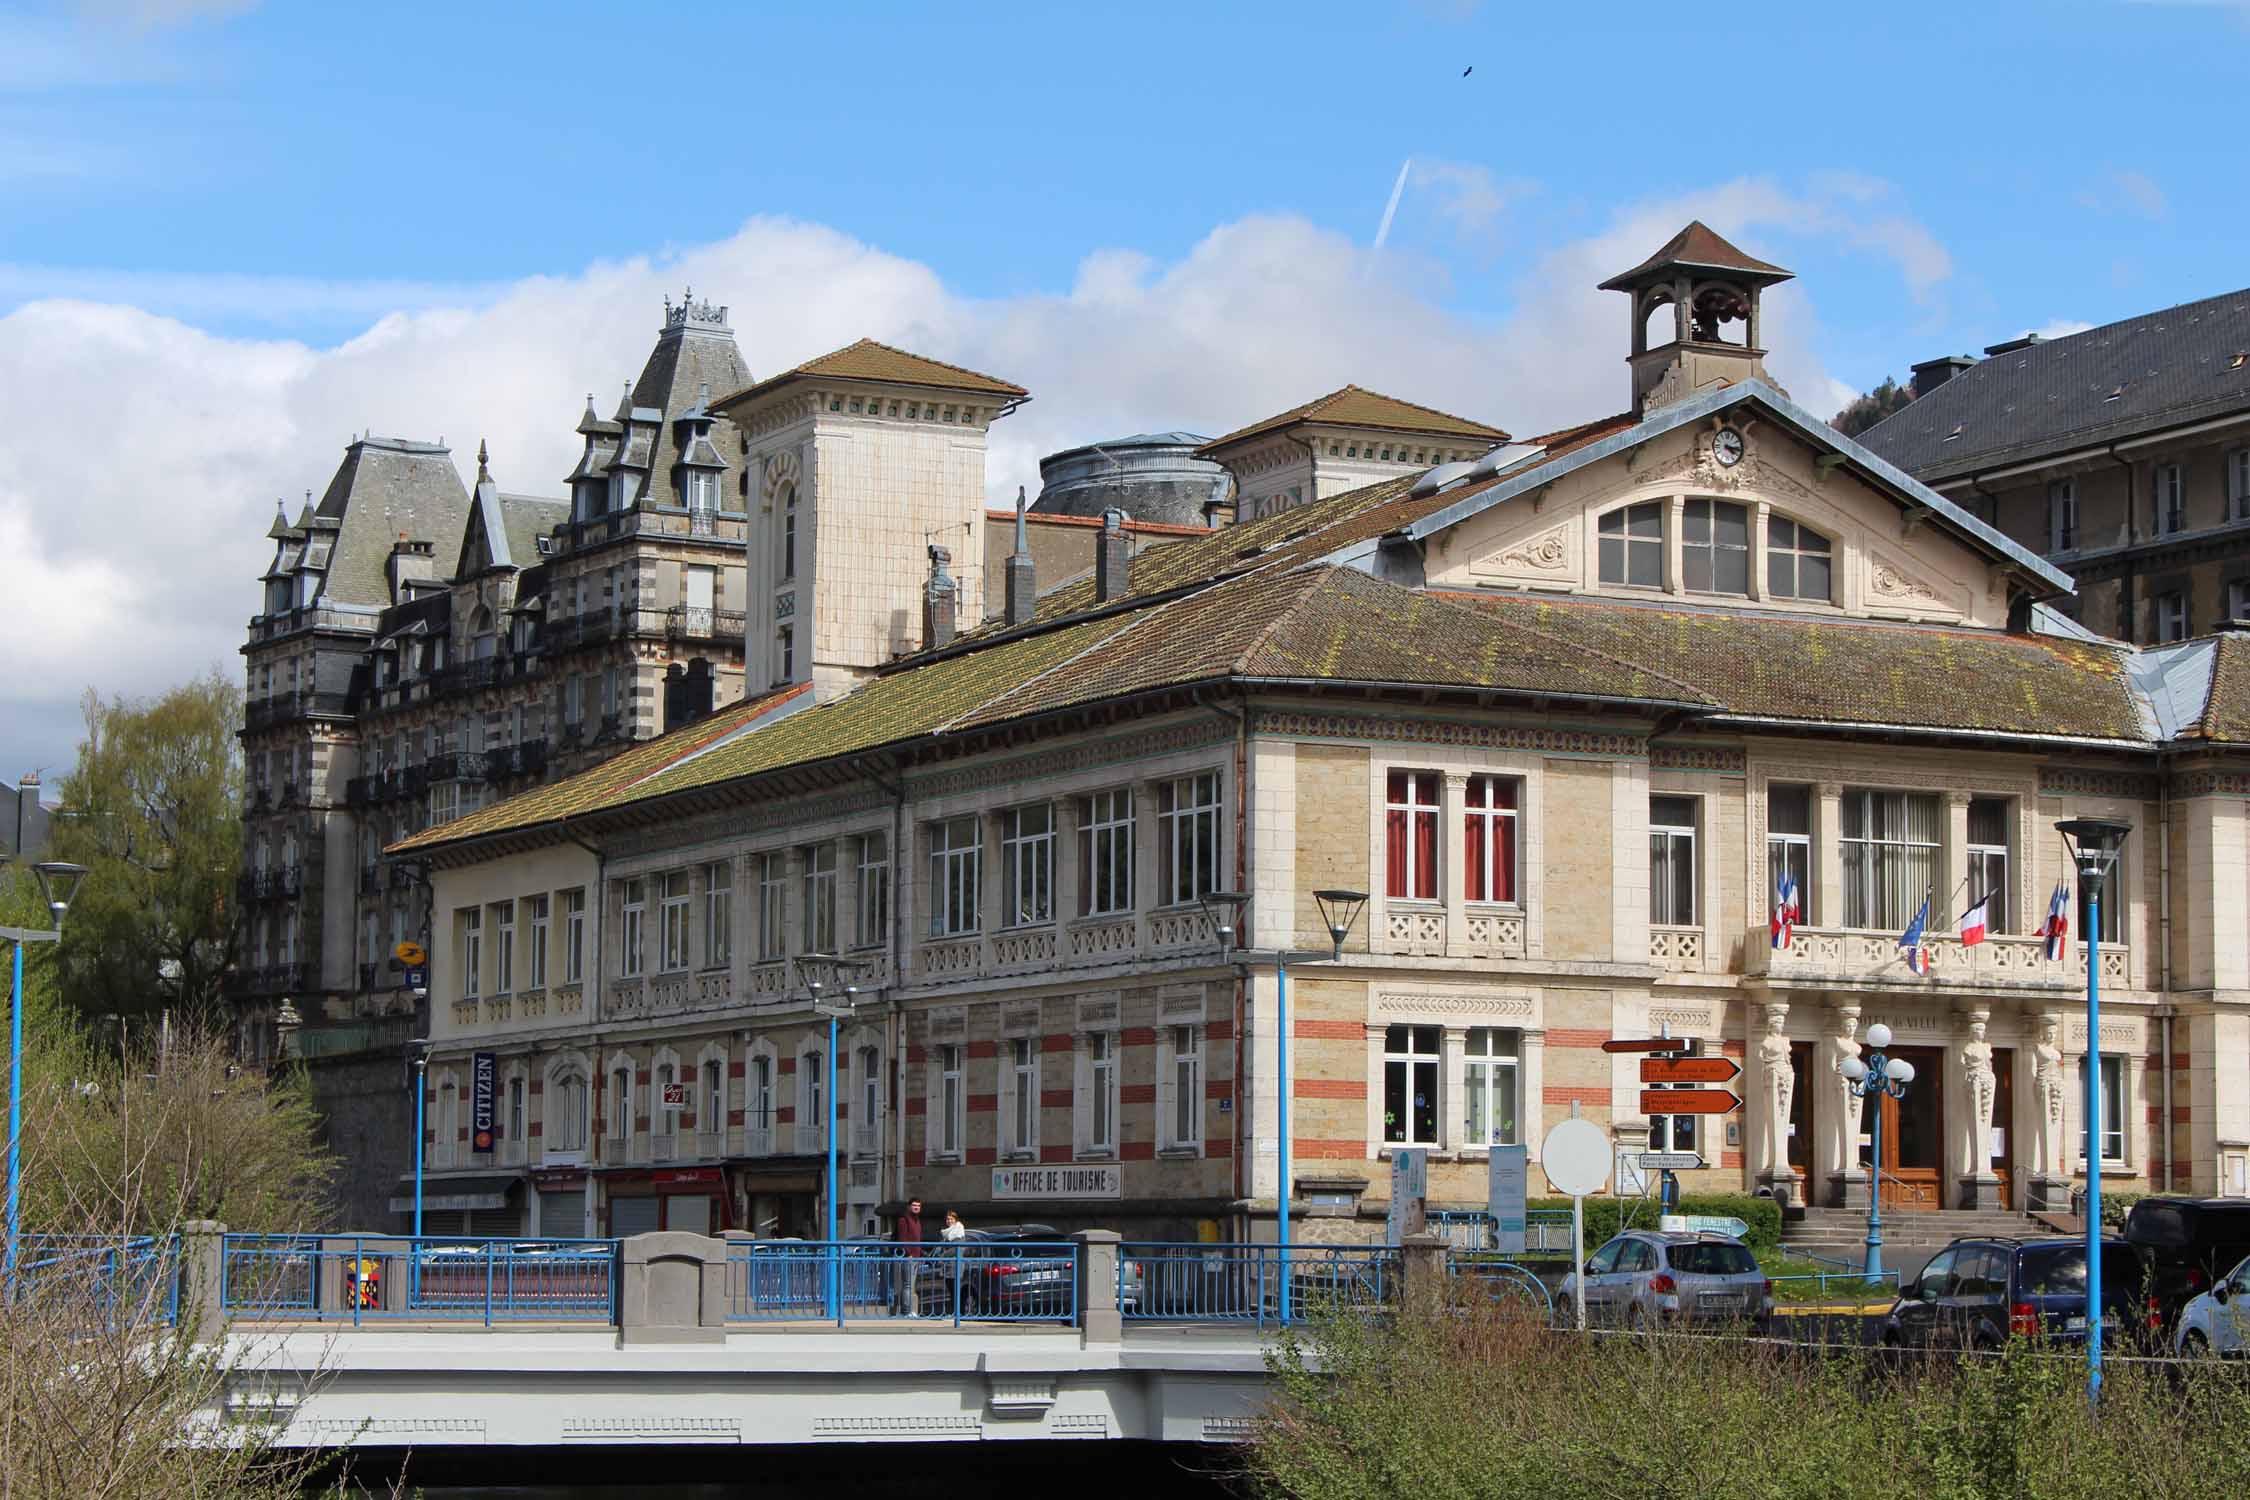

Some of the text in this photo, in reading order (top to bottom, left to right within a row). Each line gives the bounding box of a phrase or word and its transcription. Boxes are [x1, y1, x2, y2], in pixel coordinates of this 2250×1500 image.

[476, 1057, 492, 1131] CITIZEN
[1012, 1169, 1107, 1193] OFFICE DE TOURISME
